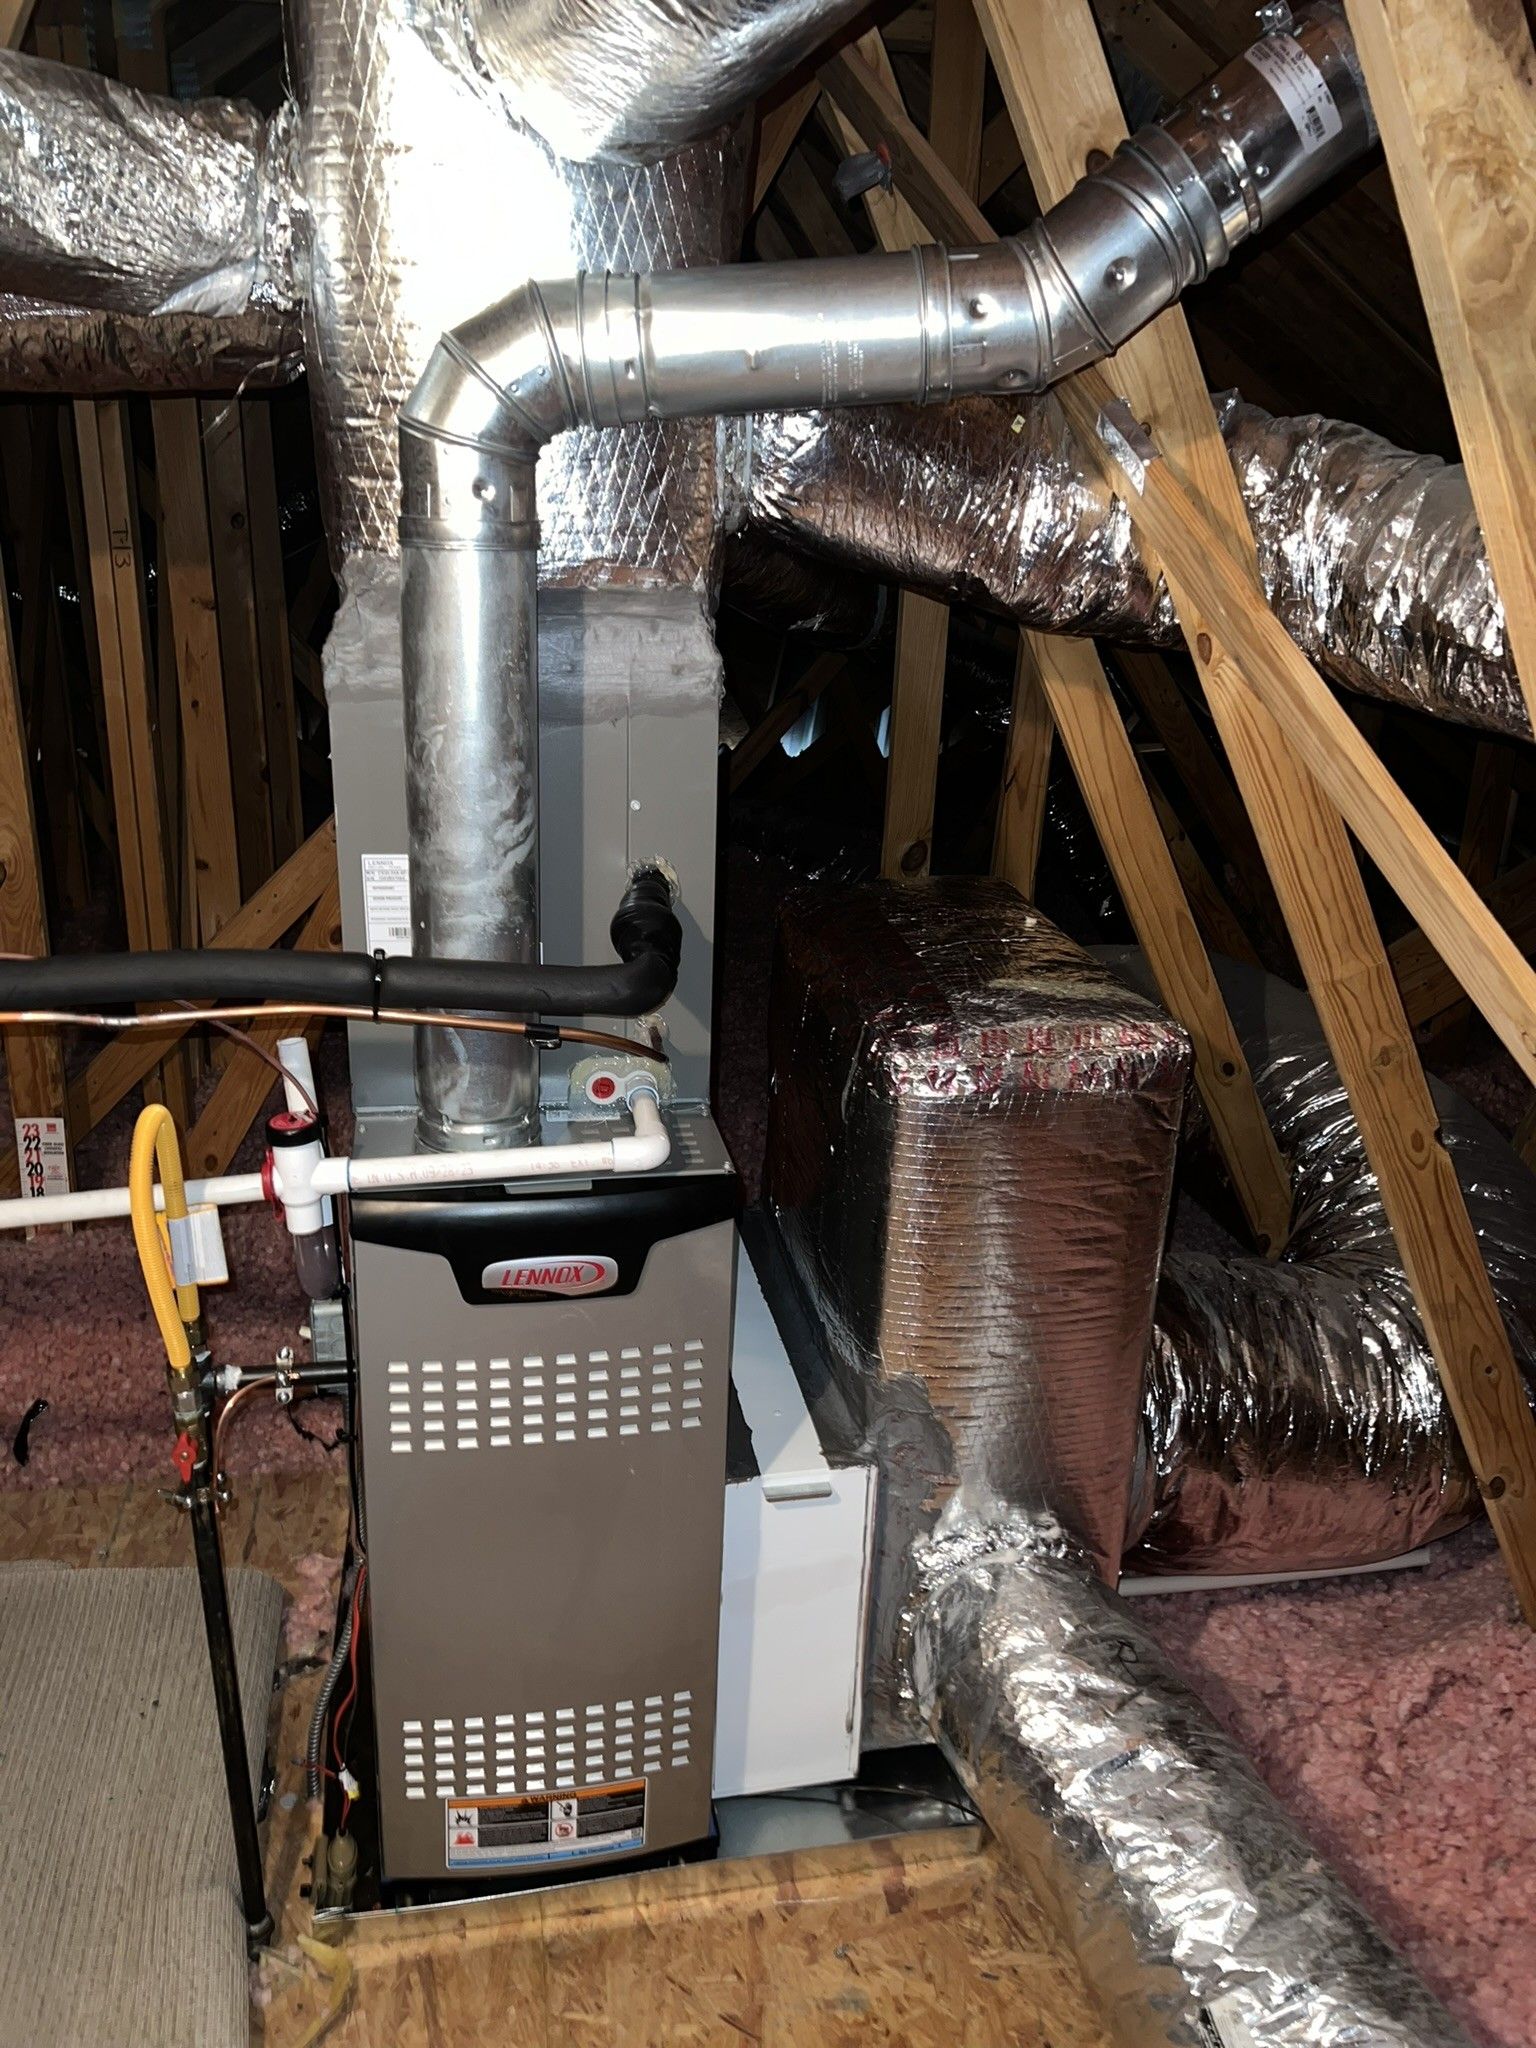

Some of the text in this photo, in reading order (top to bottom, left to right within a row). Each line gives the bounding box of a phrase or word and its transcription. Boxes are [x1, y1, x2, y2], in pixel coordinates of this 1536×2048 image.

[112, 518, 132, 569] T-13
[22, 1123, 40, 1137] 23
[23, 1136, 41, 1150] 22
[25, 1150, 41, 1163] 21
[26, 1162, 43, 1176] 20
[29, 1176, 45, 1188] 19
[501, 1265, 585, 1285] LENNOX
[530, 1791, 576, 1803] WARNING
